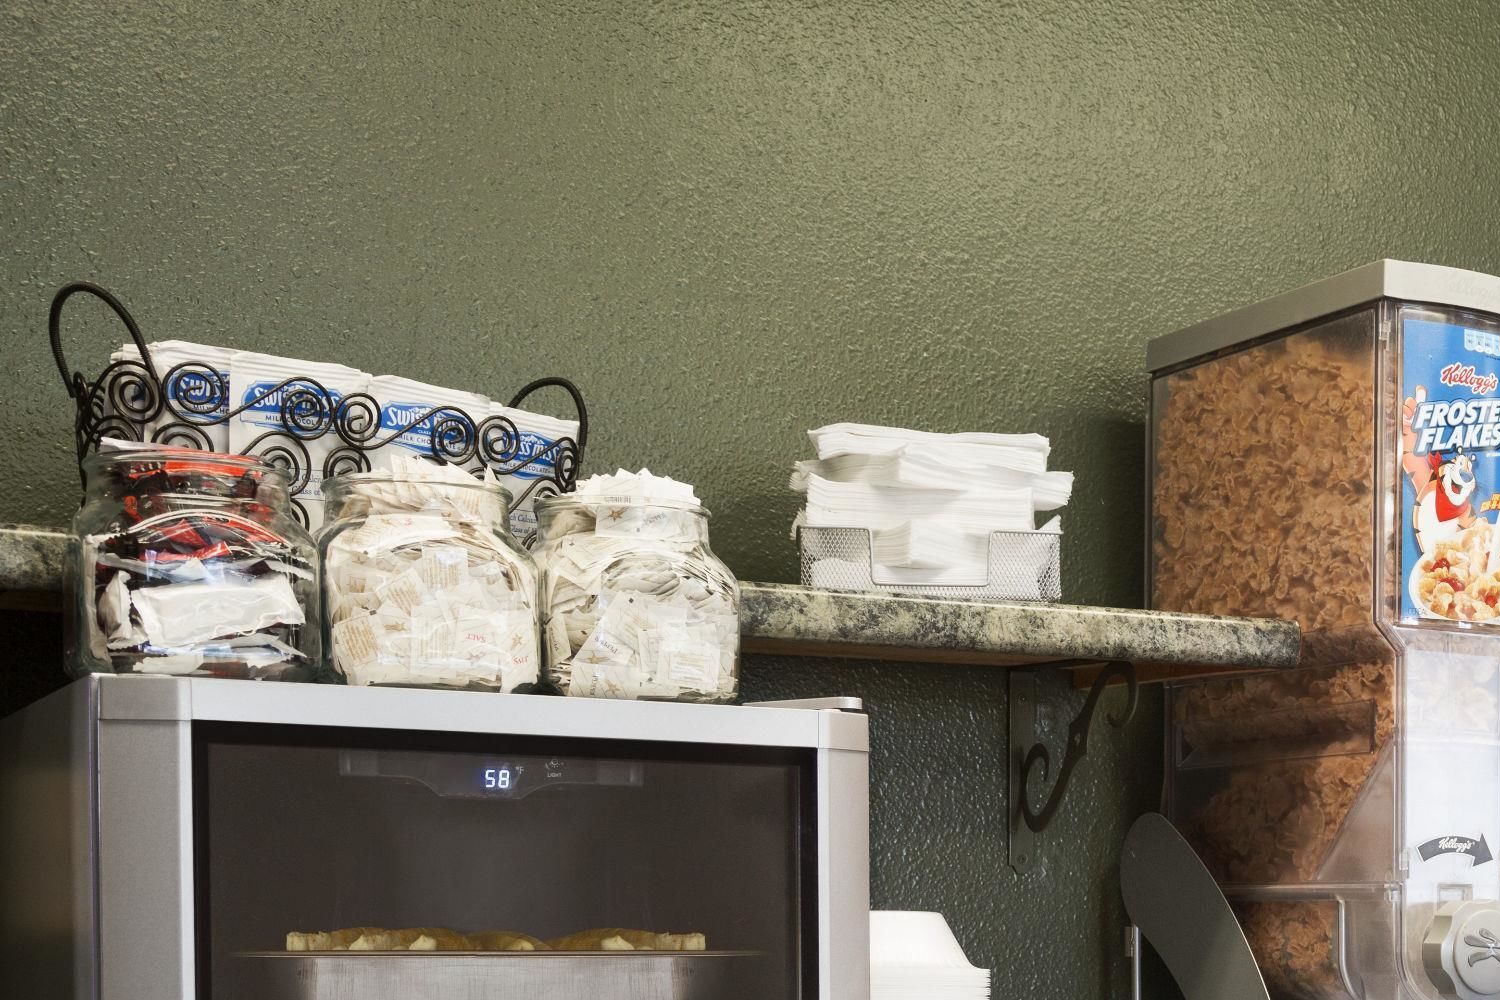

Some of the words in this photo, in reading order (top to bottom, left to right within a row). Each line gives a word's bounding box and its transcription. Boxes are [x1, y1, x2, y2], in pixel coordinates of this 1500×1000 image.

[1441, 362, 1498, 394] Kellogg's
[484, 769, 510, 789] 58
[1438, 836, 1473, 853] Kellogg's
